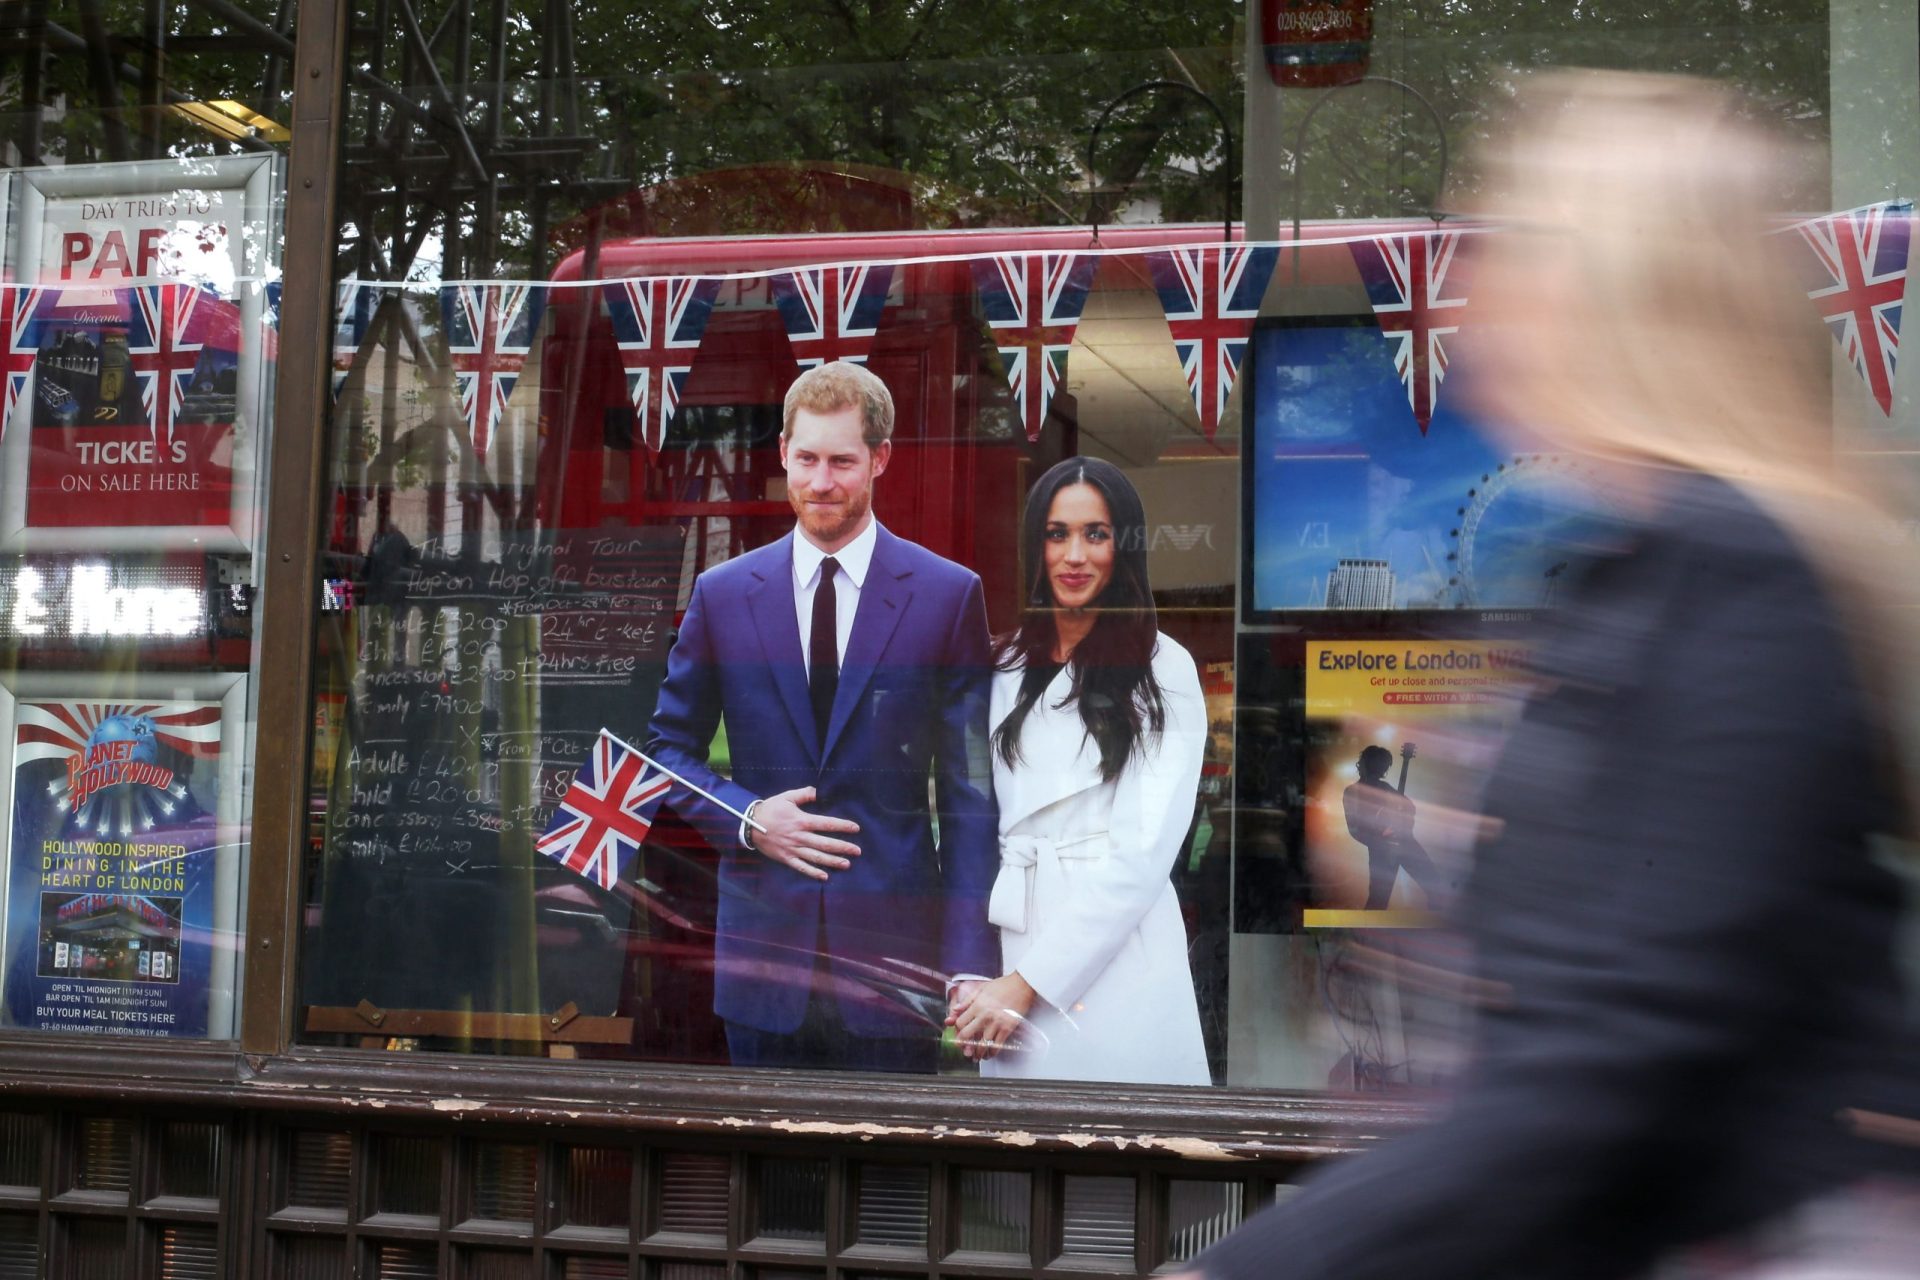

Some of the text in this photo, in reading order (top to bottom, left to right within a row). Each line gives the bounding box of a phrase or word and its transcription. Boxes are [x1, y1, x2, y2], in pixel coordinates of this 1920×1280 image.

[82, 198, 211, 221] DAY TRIPS TO
[76, 440, 187, 465] TICKES
[61, 472, 199, 492] ON SALE HERE
[587, 537, 642, 556] Tour
[488, 566, 529, 595] Hop
[1481, 612, 1533, 622] SAMSUNG
[1319, 650, 1397, 670] Explore
[1404, 650, 1480, 670] London
[1370, 676, 1386, 686] Get
[1388, 678, 1400, 686] up
[1402, 676, 1426, 686] close
[1428, 677, 1445, 686] and
[1447, 676, 1487, 687] personal
[1396, 694, 1421, 703] FREE
[1423, 694, 1448, 703] WITH
[497, 740, 531, 756] From
[64, 740, 140, 792] PLANET
[345, 745, 410, 775] Adult
[68, 762, 174, 814] HOLLYWOOD
[43, 840, 186, 858] HOLLYWOOD INSPIRED
[43, 856, 185, 875] DINING IN THE
[41, 873, 184, 891] HEART OF LONDON
[45, 993, 60, 1001] BAR
[61, 994, 80, 1003] OPEN
[52, 984, 72, 992] OPEN
[86, 986, 120, 995] MIDNIGHT
[36, 1006, 176, 1024] BUY YOUR MEAL TICKETS HERE
[61, 1023, 103, 1033] HAYMARKET
